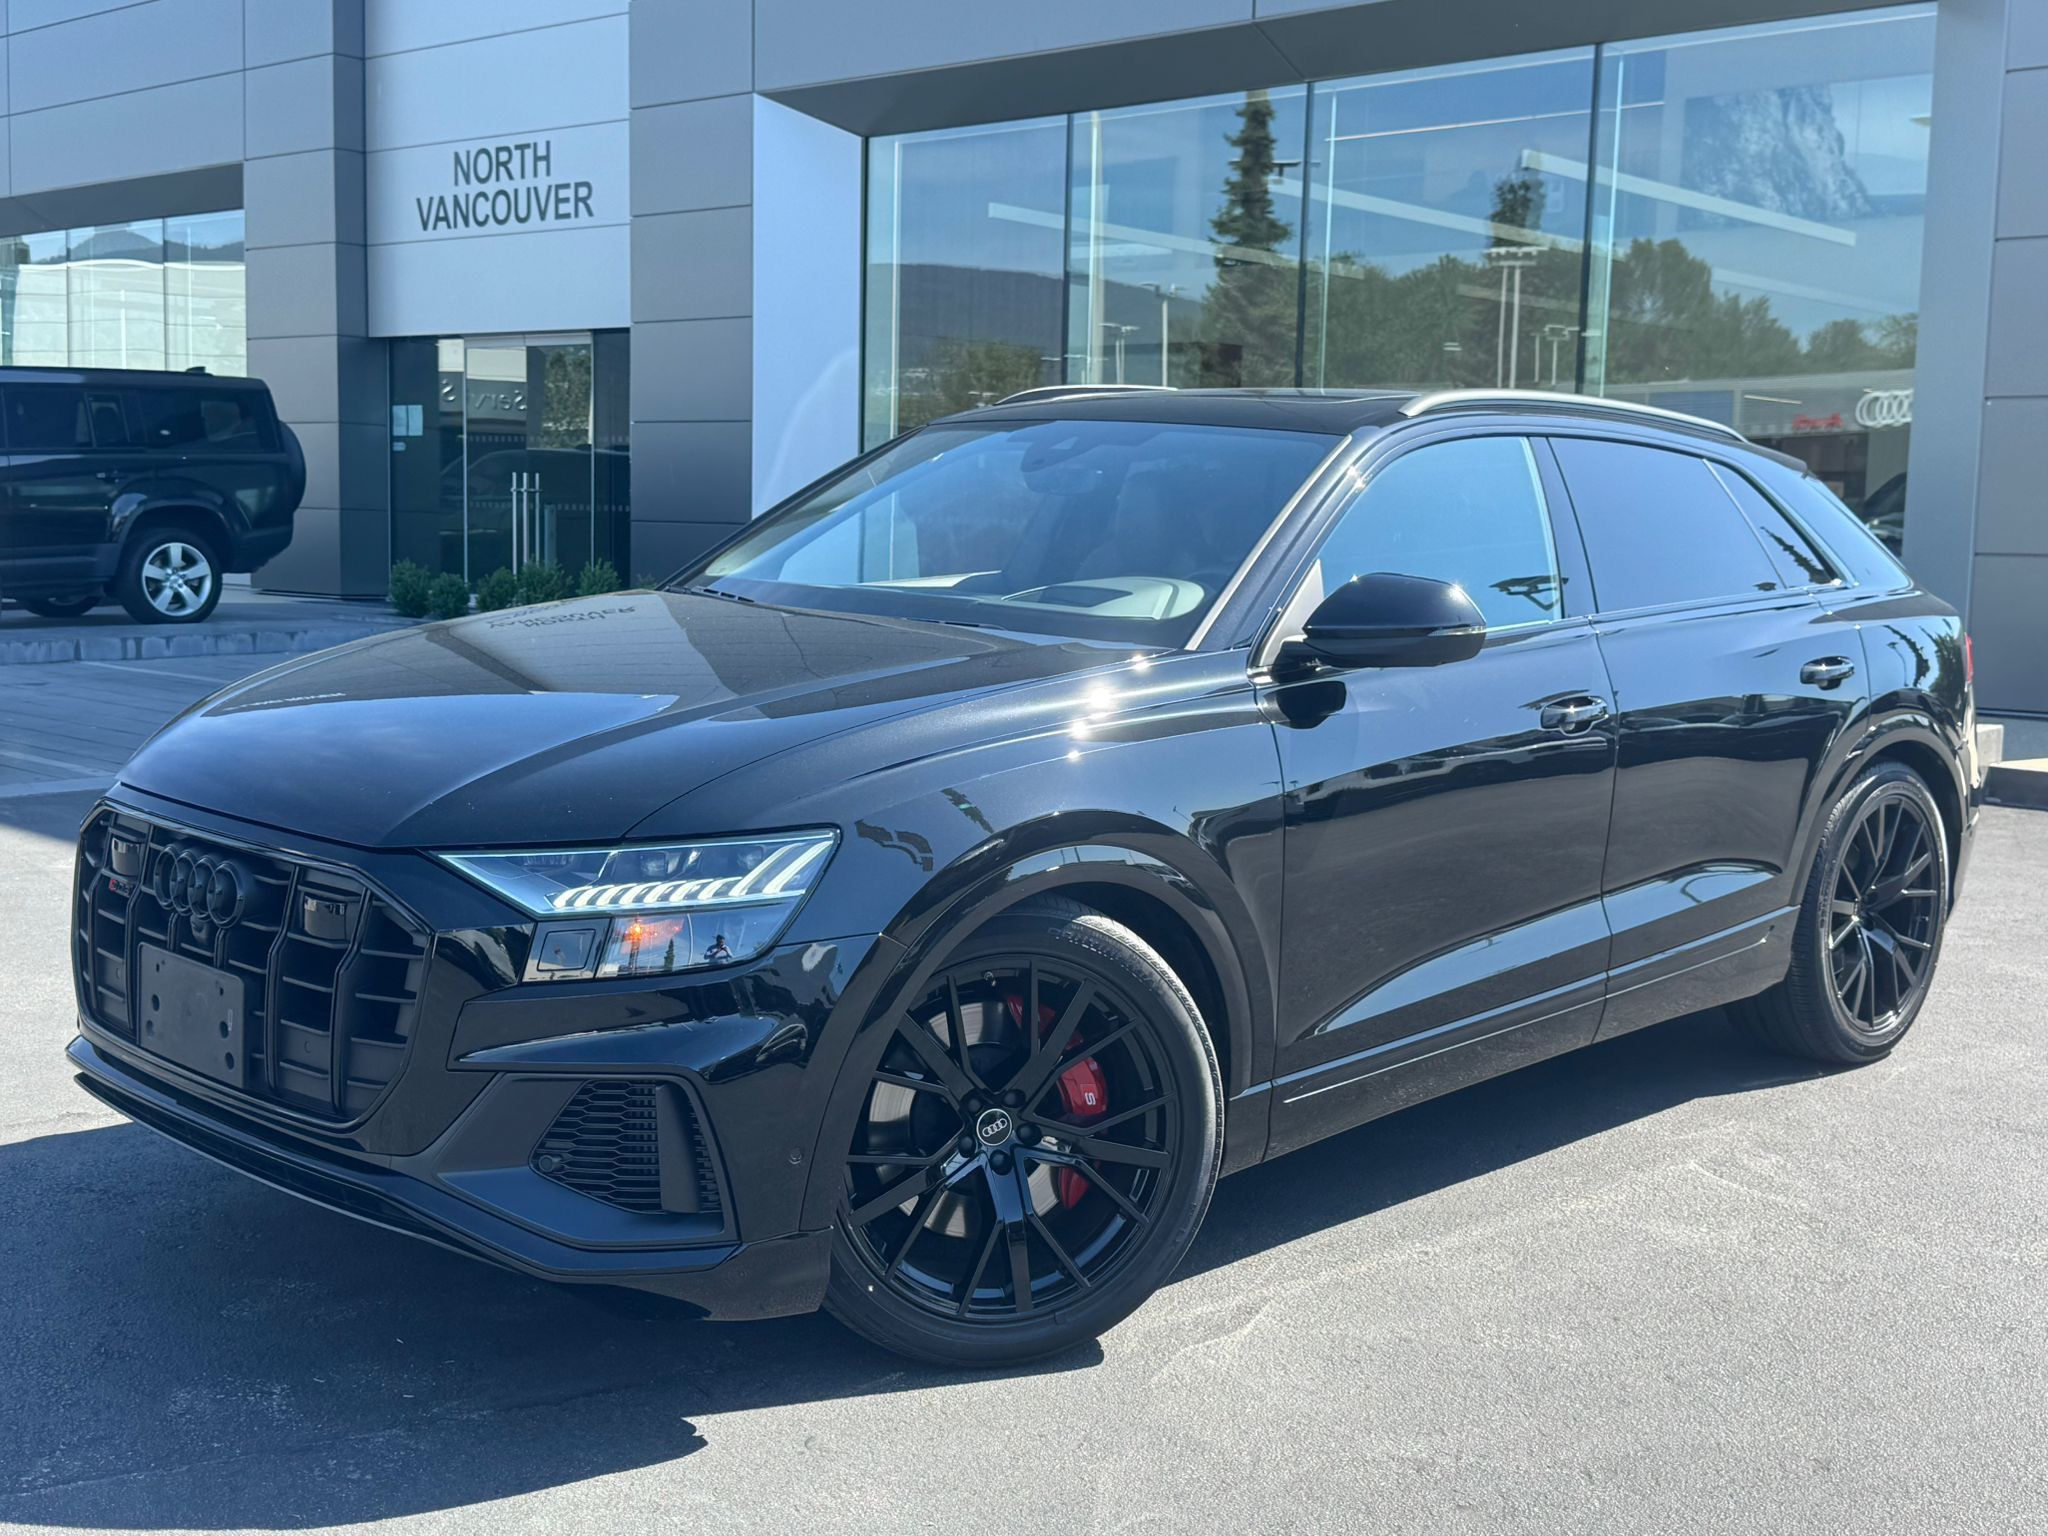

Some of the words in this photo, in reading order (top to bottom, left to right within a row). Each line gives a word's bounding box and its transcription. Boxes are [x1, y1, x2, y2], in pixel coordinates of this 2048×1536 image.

[454, 140, 551, 187] NORTH
[416, 181, 594, 232] VANCOUVER
[1084, 1092, 1096, 1106] S
